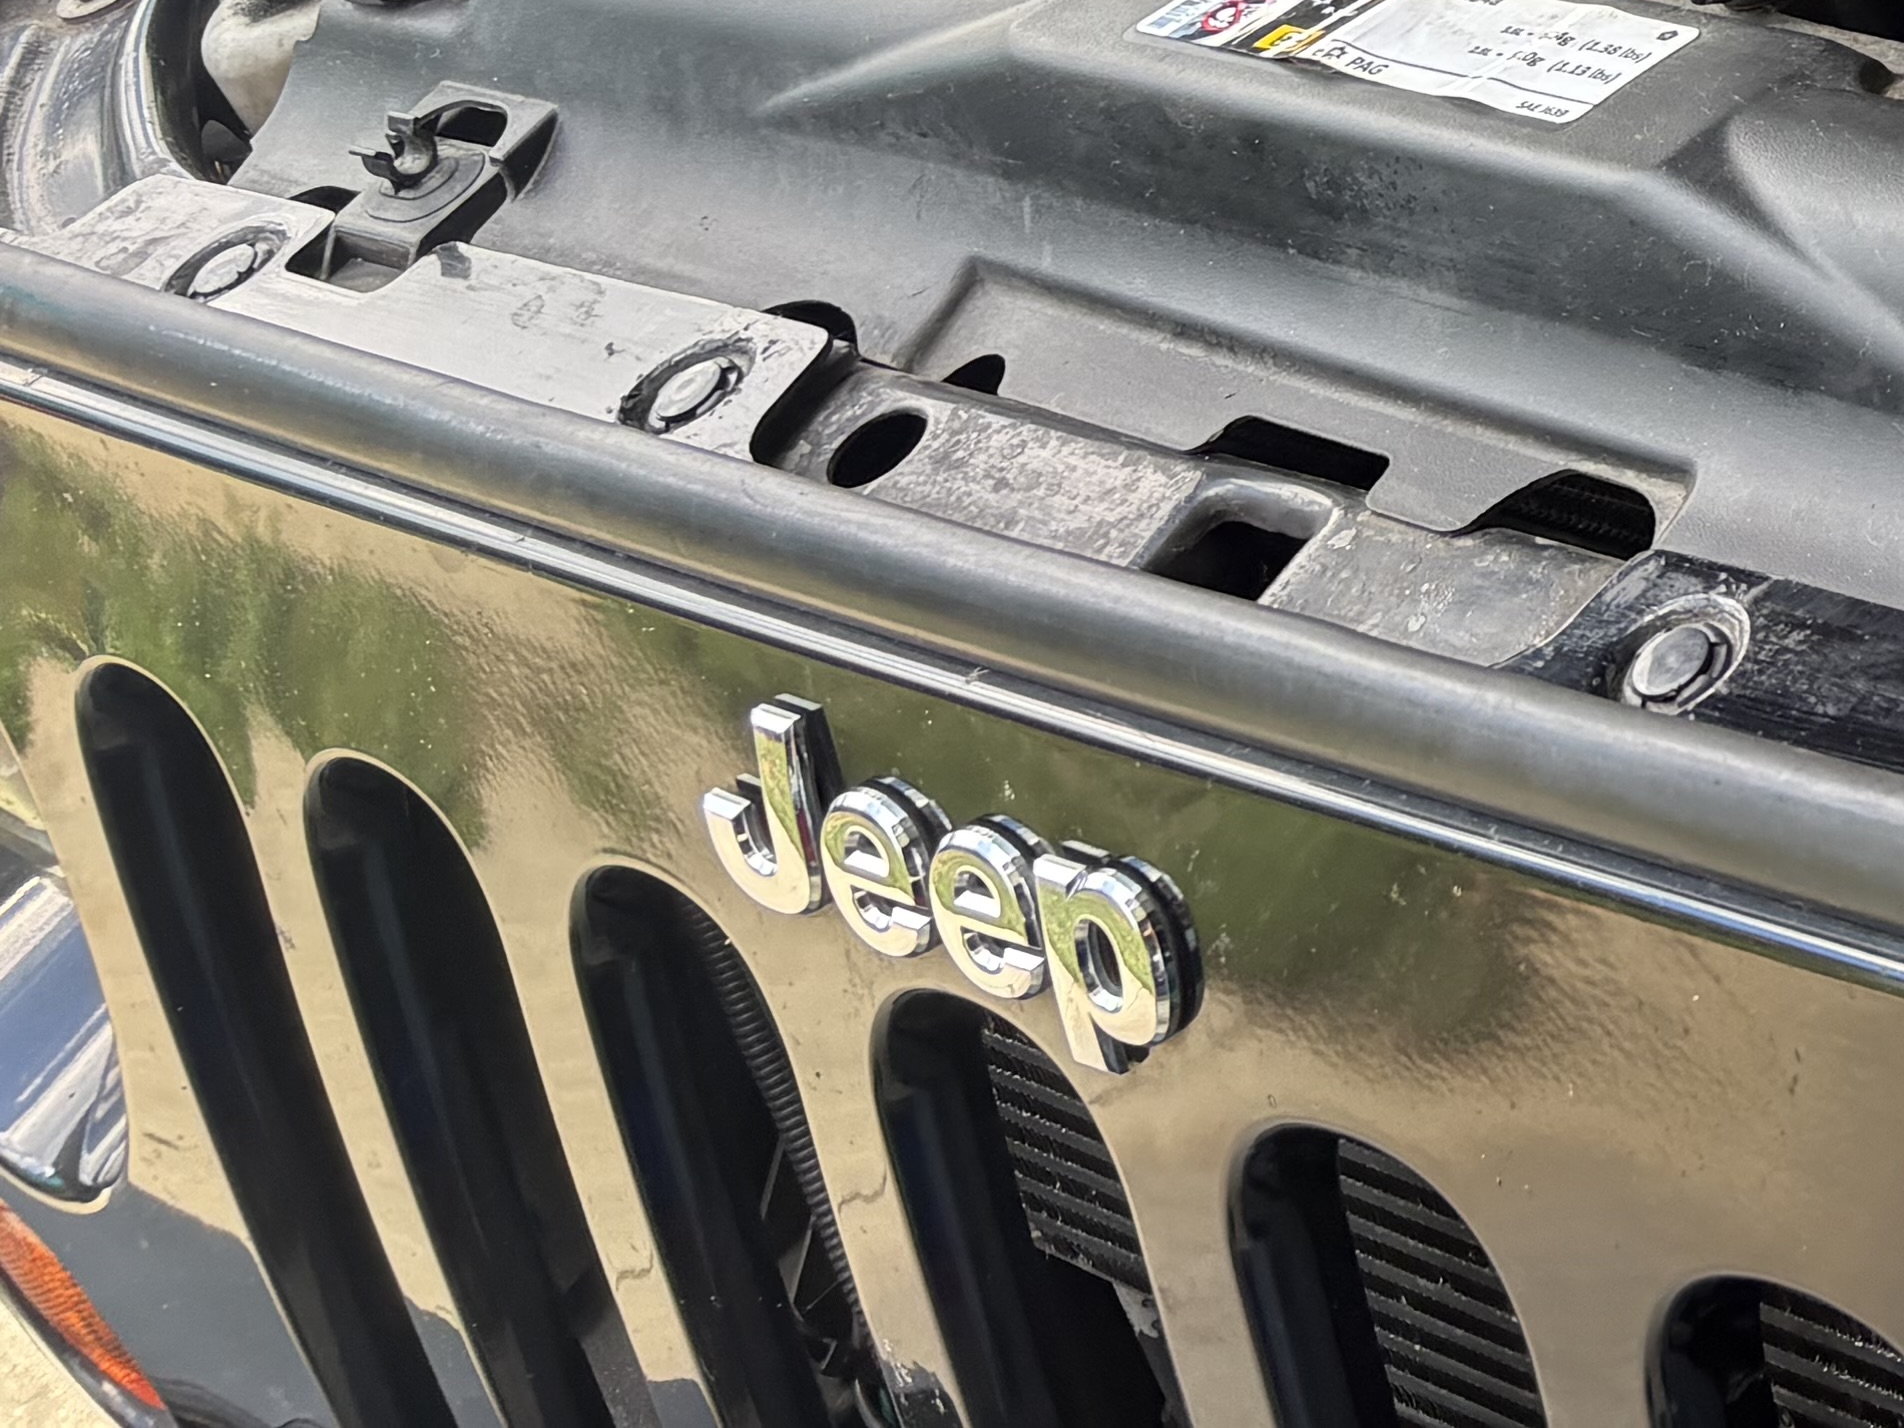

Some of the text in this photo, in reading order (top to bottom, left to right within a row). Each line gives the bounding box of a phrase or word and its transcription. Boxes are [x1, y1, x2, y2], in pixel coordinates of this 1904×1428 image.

[1344, 56, 1390, 76] PAG
[1618, 46, 1653, 64] lbs)
[1546, 59, 1592, 77] (1.13
[1588, 67, 1623, 85] lbs)
[702, 692, 1205, 1075] Jeep
